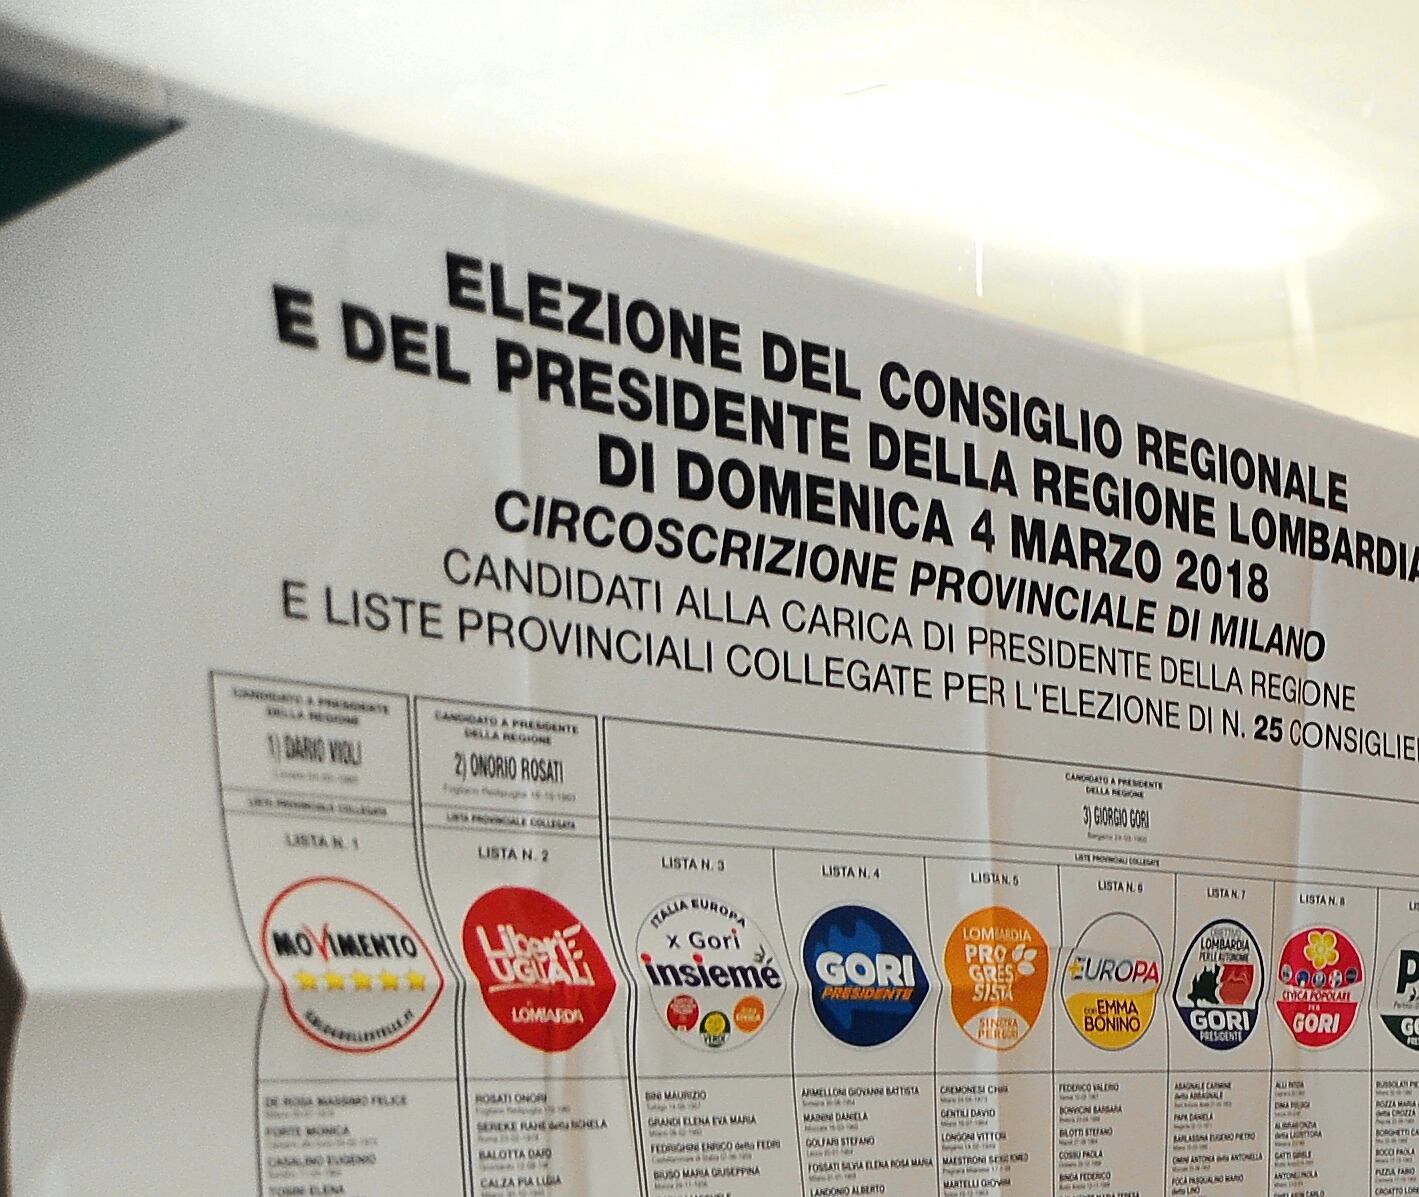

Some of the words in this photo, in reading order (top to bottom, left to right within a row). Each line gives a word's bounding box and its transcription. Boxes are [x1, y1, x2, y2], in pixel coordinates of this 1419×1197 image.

[446, 251, 742, 372] ELEZIONE
[762, 331, 861, 400] DEL
[879, 360, 1122, 458] CONSIGLIO
[1137, 422, 1348, 513] REGIONALE
[273, 284, 318, 348] E
[343, 302, 470, 384] DEL
[497, 338, 850, 462] PRESIDENTE
[869, 422, 1017, 497] DELLA
[1033, 460, 1215, 537] REGIONE
[600, 433, 655, 492] DI
[678, 449, 953, 545] DOMENICA
[970, 508, 995, 552] 4
[1011, 514, 1161, 582] MARZO
[1176, 549, 1269, 603] 2018
[495, 490, 897, 592] CIRCOSCRIZIONE
[910, 560, 1156, 635] PROVINCIALE
[1167, 603, 1200, 642] DI
[1209, 608, 1325, 663] MILANO
[443, 548, 661, 613] CANDIDATI
[676, 585, 770, 629] ALLA
[781, 601, 911, 647] CARICA
[924, 621, 953, 654] DI
[969, 627, 1151, 681] PRESIDENTE
[1160, 657, 1242, 695] DELLA
[1250, 672, 1355, 712] REGIONE
[283, 580, 308, 619] E
[326, 586, 443, 638] LISTE
[459, 608, 712, 673] PROVINCIALI
[726, 644, 931, 700] COLLEGATE
[944, 671, 1004, 708] PER
[1016, 681, 1181, 729] L'ELEZIONE
[1190, 705, 1213, 732] DI
[1222, 709, 1246, 738] N.
[1253, 715, 1283, 742] 25
[455, 752, 467, 777] 2)
[470, 754, 516, 779] ONORIO
[522, 757, 563, 784] ROSATI
[1083, 806, 1091, 825] 3)
[1094, 806, 1127, 828] GIORGIO
[1130, 810, 1150, 830] GORI
[478, 846, 517, 860] LISTA
[522, 847, 537, 861] N.
[541, 849, 549, 861] 2
[650, 900, 688, 929] ITALIA
[691, 899, 746, 928] EUROPA
[272, 921, 417, 961] MOVIMENTO
[666, 935, 680, 949] x
[689, 928, 741, 949] Gori
[1201, 938, 1249, 950] LOMBARDIA
[965, 944, 1007, 963] PRO
[641, 953, 781, 988] insieme
[815, 951, 915, 987] GORI
[969, 963, 1014, 984] GRES
[1074, 956, 1159, 984] EUROPA
[821, 986, 913, 1001] PRESIDENTE
[973, 983, 1014, 1002] SISTA
[1097, 999, 1138, 1015] EMMA
[1084, 1015, 1140, 1032] BONINO
[1190, 1010, 1249, 1031] GORI
[1293, 1013, 1340, 1033] GORI
[1200, 1031, 1242, 1042] PRESIDENTE
